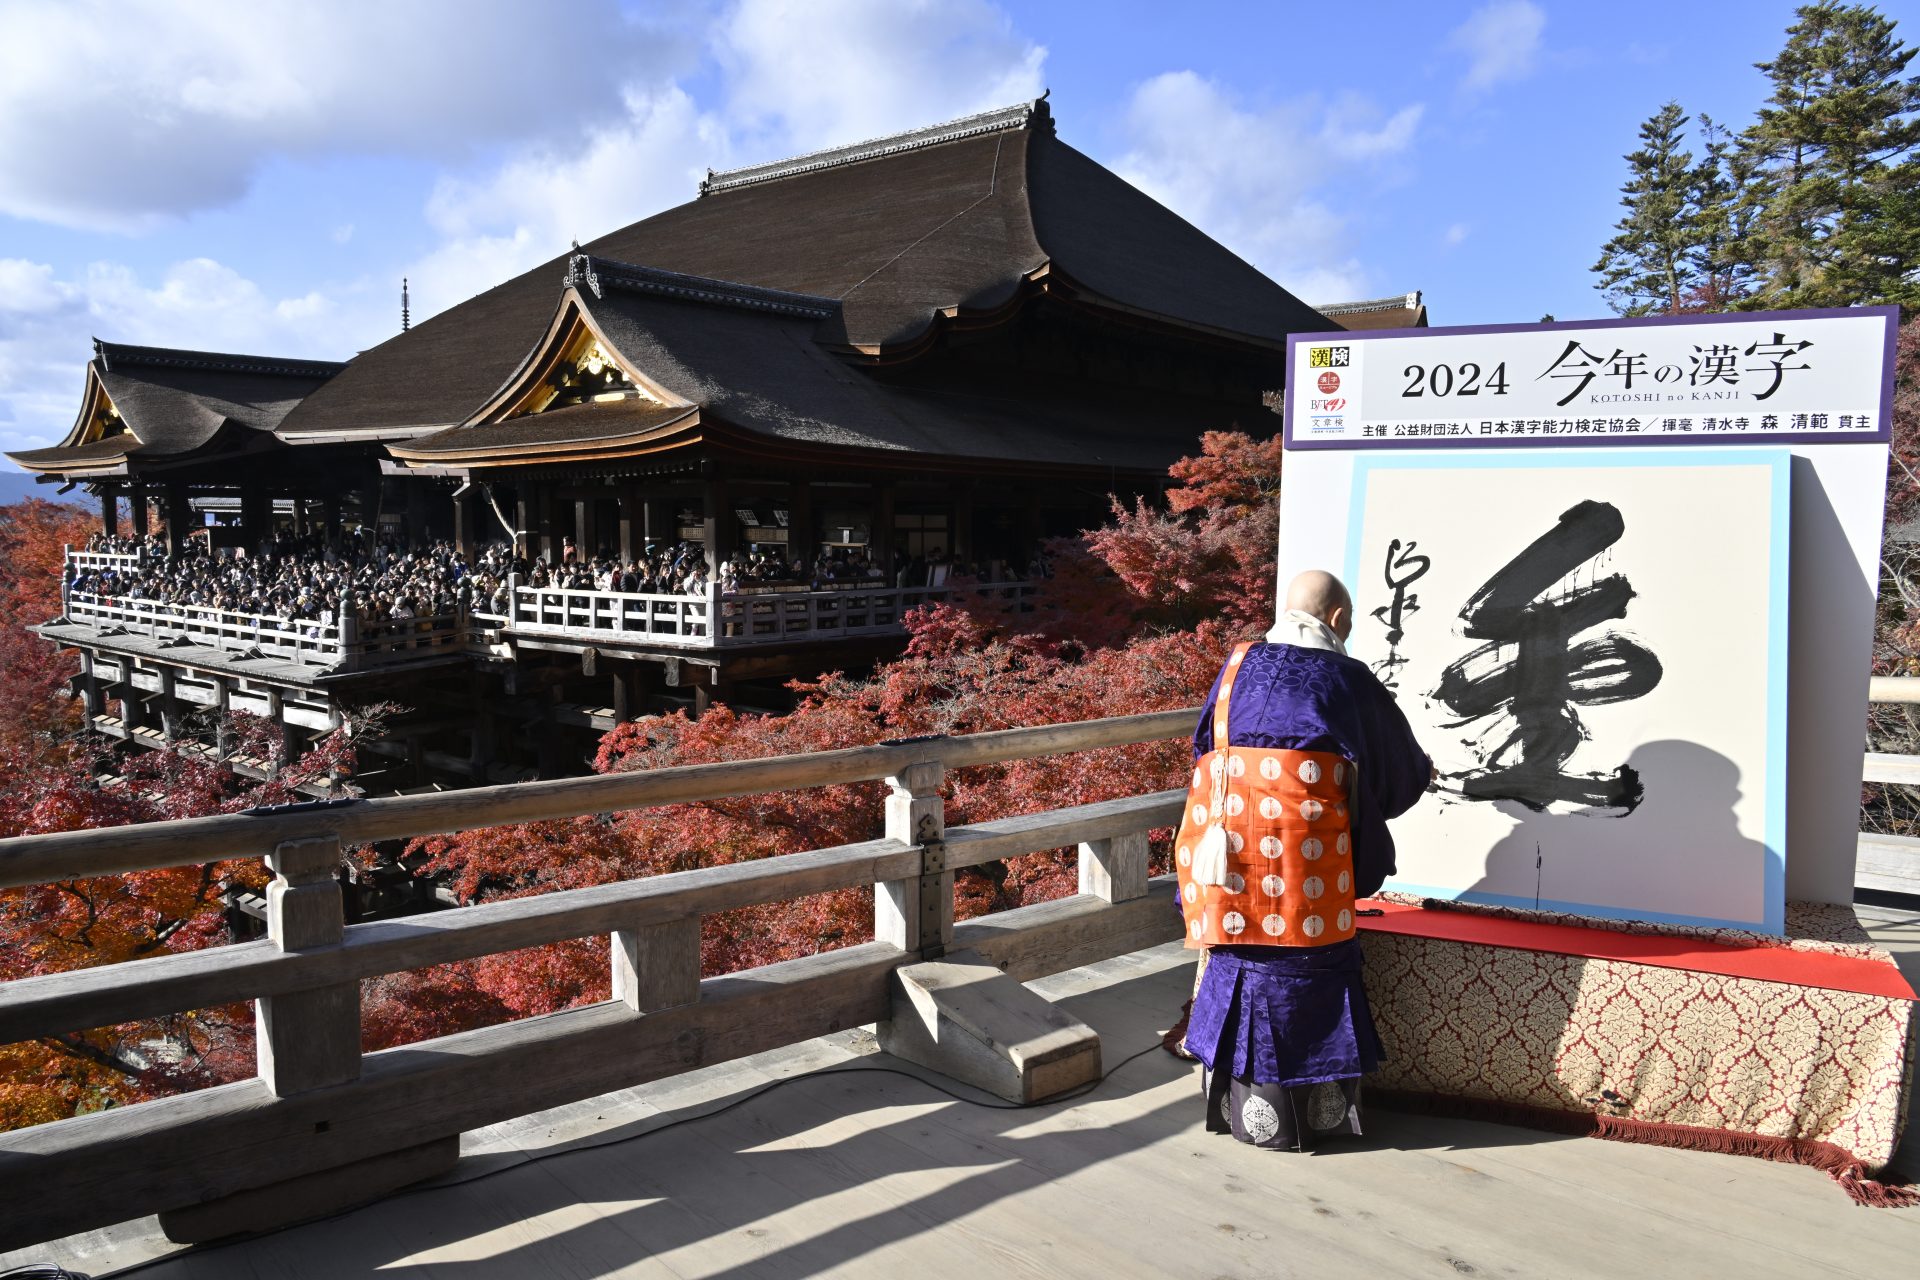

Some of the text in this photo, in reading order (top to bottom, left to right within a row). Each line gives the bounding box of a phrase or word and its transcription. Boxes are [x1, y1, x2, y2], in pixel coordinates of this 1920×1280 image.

[1311, 347, 1349, 367] 漢検
[1402, 361, 1510, 398] 2024
[1535, 332, 1814, 407] 今年の漢字
[1590, 393, 1660, 403] KOTOSHI
[1691, 391, 1739, 400] KANJI
[1362, 424, 1387, 437] 主催
[1394, 422, 1473, 436] 公益財団法人
[1702, 417, 1750, 431] 清水寺
[1761, 414, 1779, 430] 森
[1791, 413, 1829, 429] 清範
[1838, 415, 1871, 429] 貫主
